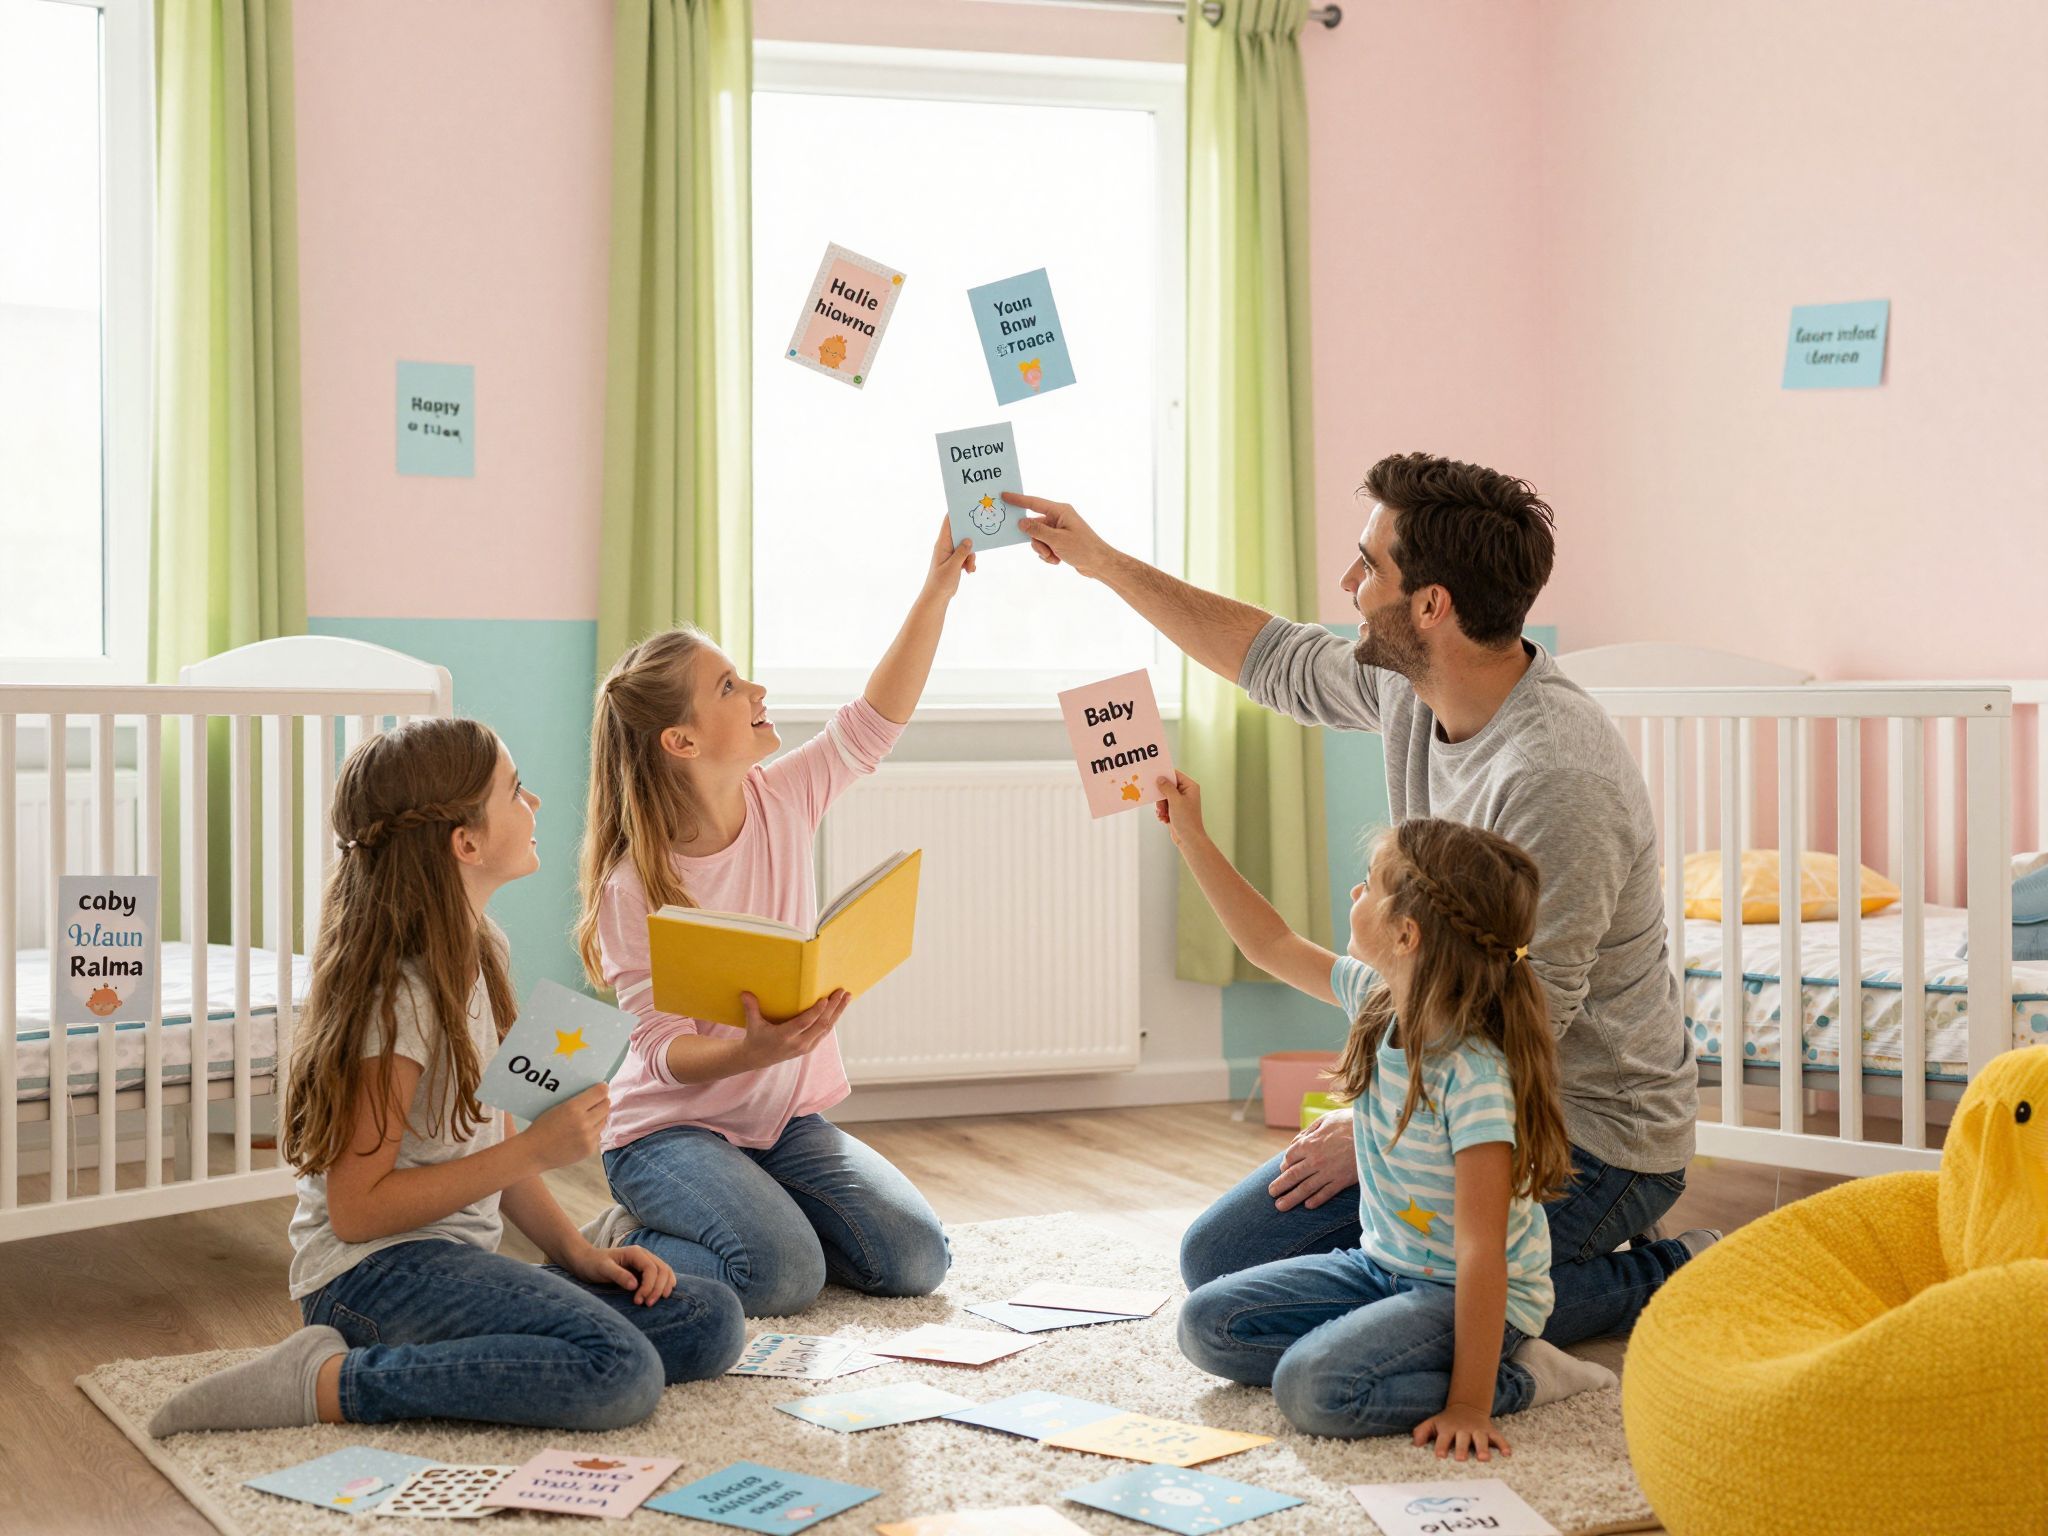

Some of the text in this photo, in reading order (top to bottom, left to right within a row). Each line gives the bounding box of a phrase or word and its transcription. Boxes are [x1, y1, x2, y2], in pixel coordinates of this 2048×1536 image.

[830, 278, 878, 310] Halie
[950, 441, 1004, 463] Detrow
[961, 467, 1002, 484] Kane
[1084, 700, 1134, 727] Baby
[1102, 731, 1117, 747] a
[1090, 743, 1159, 774] mame
[79, 889, 136, 917] caby
[70, 956, 143, 977] Ralma
[508, 1055, 560, 1093] Oola
